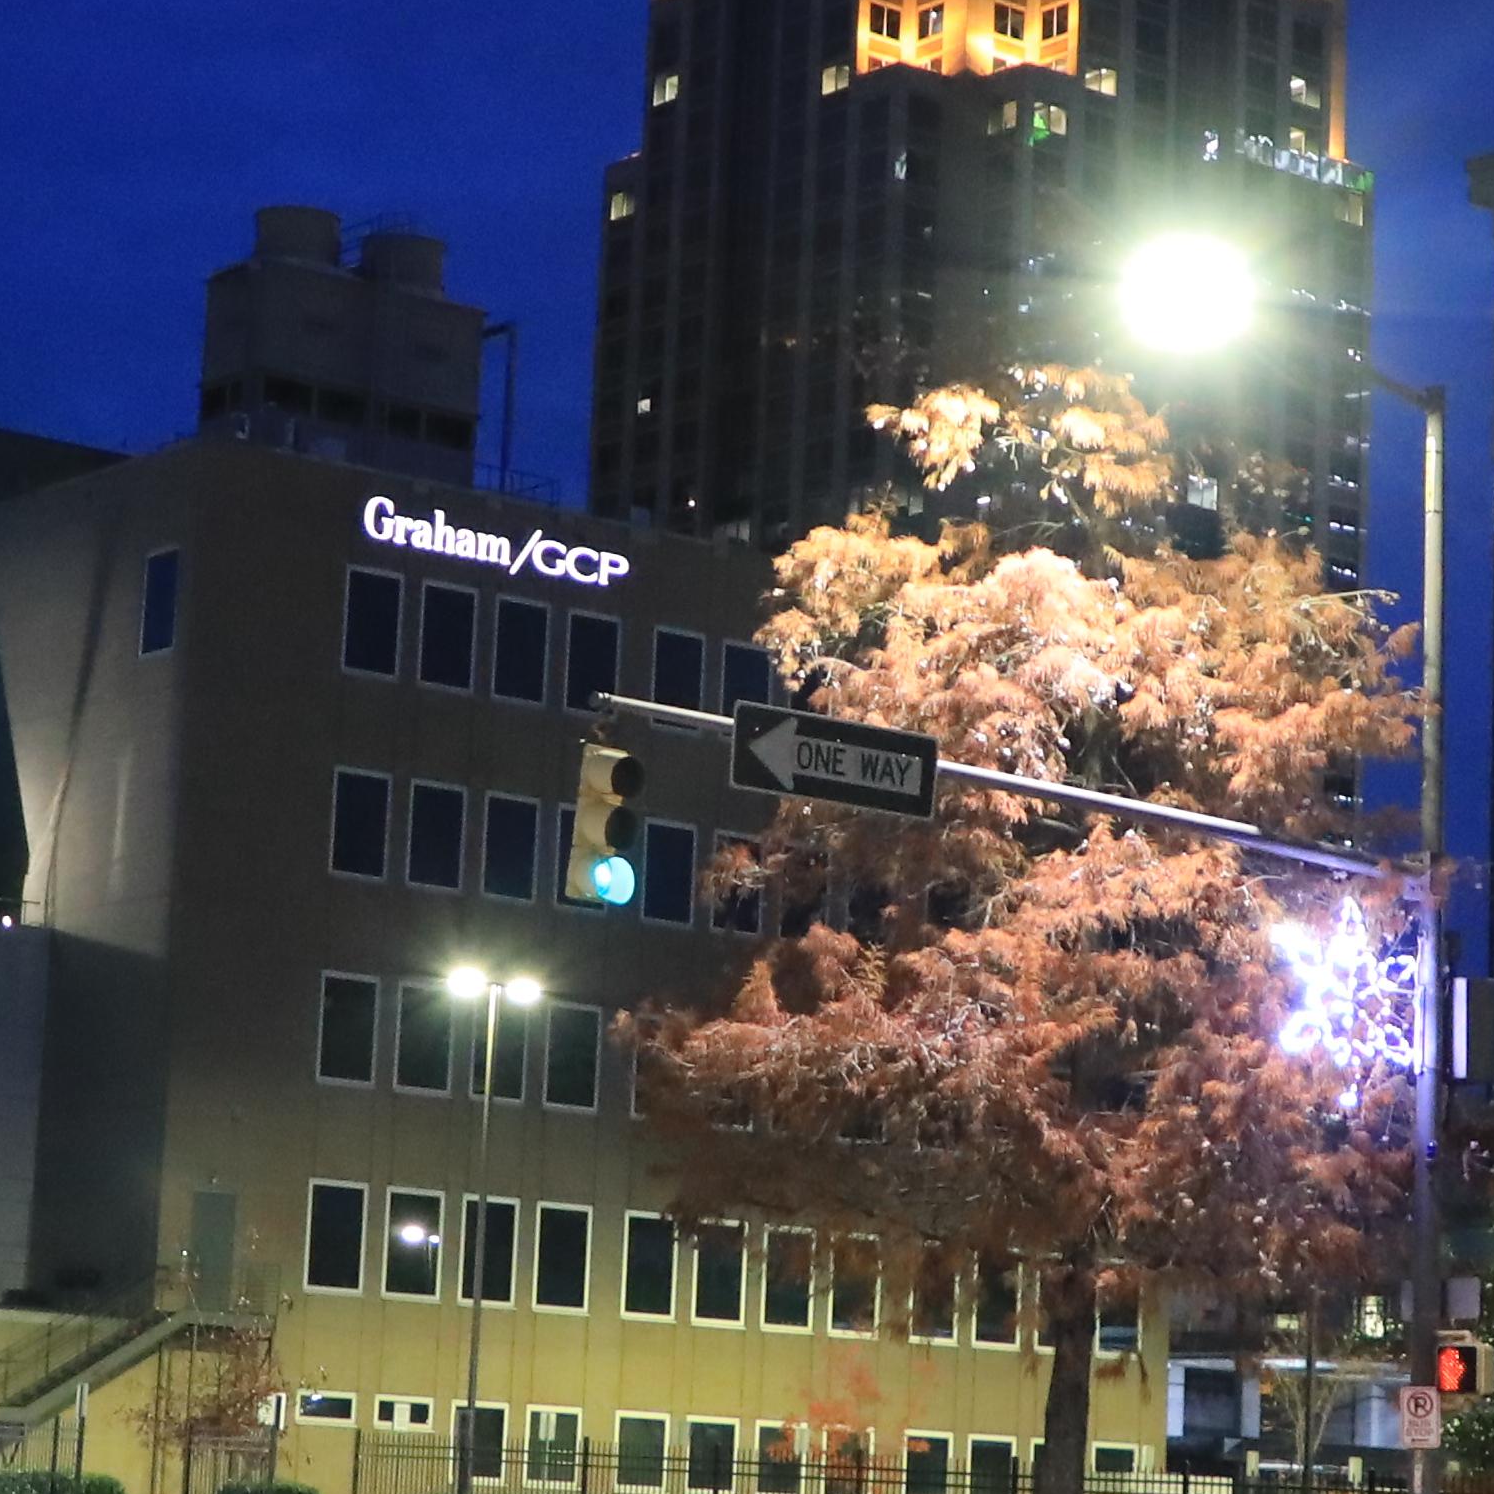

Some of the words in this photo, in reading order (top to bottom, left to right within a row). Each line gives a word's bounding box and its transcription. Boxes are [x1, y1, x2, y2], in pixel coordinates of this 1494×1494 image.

[363, 495, 630, 586] Graham/GCP
[796, 741, 846, 777] ONE
[860, 752, 913, 788] WAY
